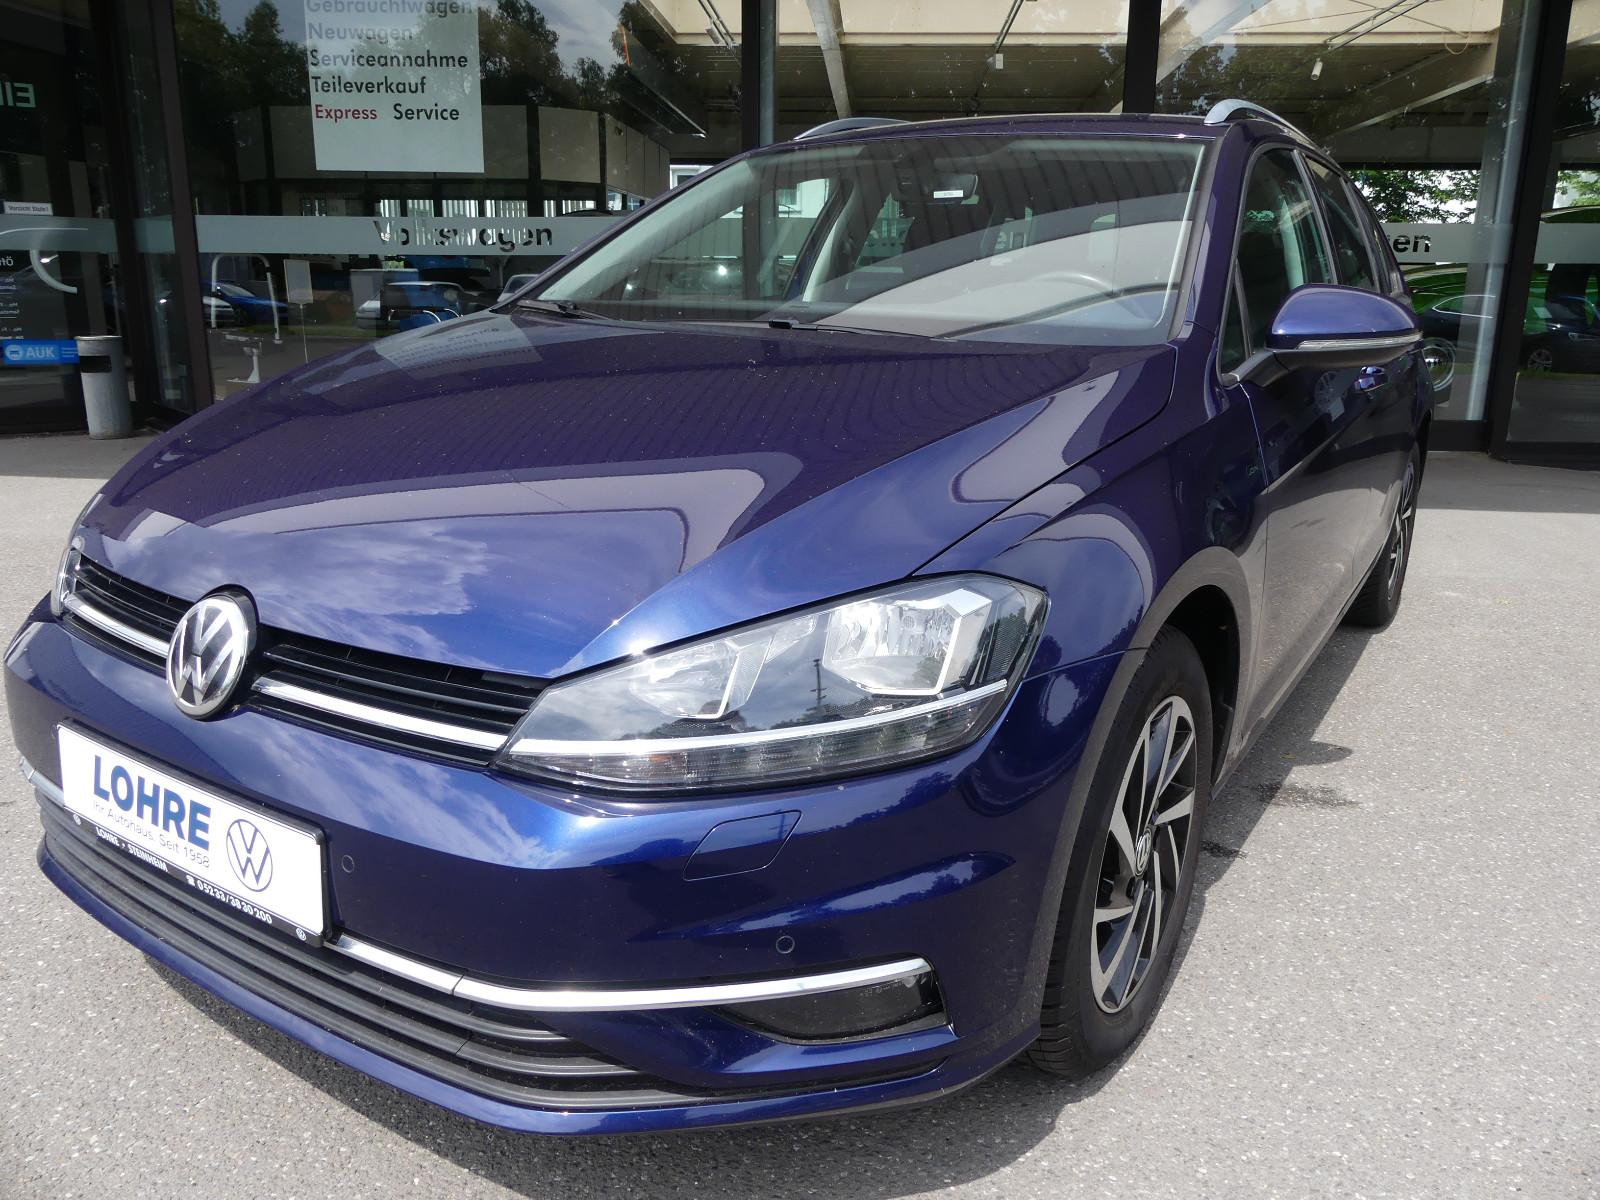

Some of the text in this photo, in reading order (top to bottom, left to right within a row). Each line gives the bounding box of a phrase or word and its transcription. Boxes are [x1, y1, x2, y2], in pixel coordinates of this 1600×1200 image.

[308, 22, 413, 45] Neuwagen
[310, 49, 469, 68] Serviceannahme
[311, 76, 427, 94] Teileverkauf
[315, 103, 460, 123] Express Service
[94, 754, 211, 851] LOHRE
[159, 833, 180, 853] Seit
[183, 846, 210, 869] 1958
